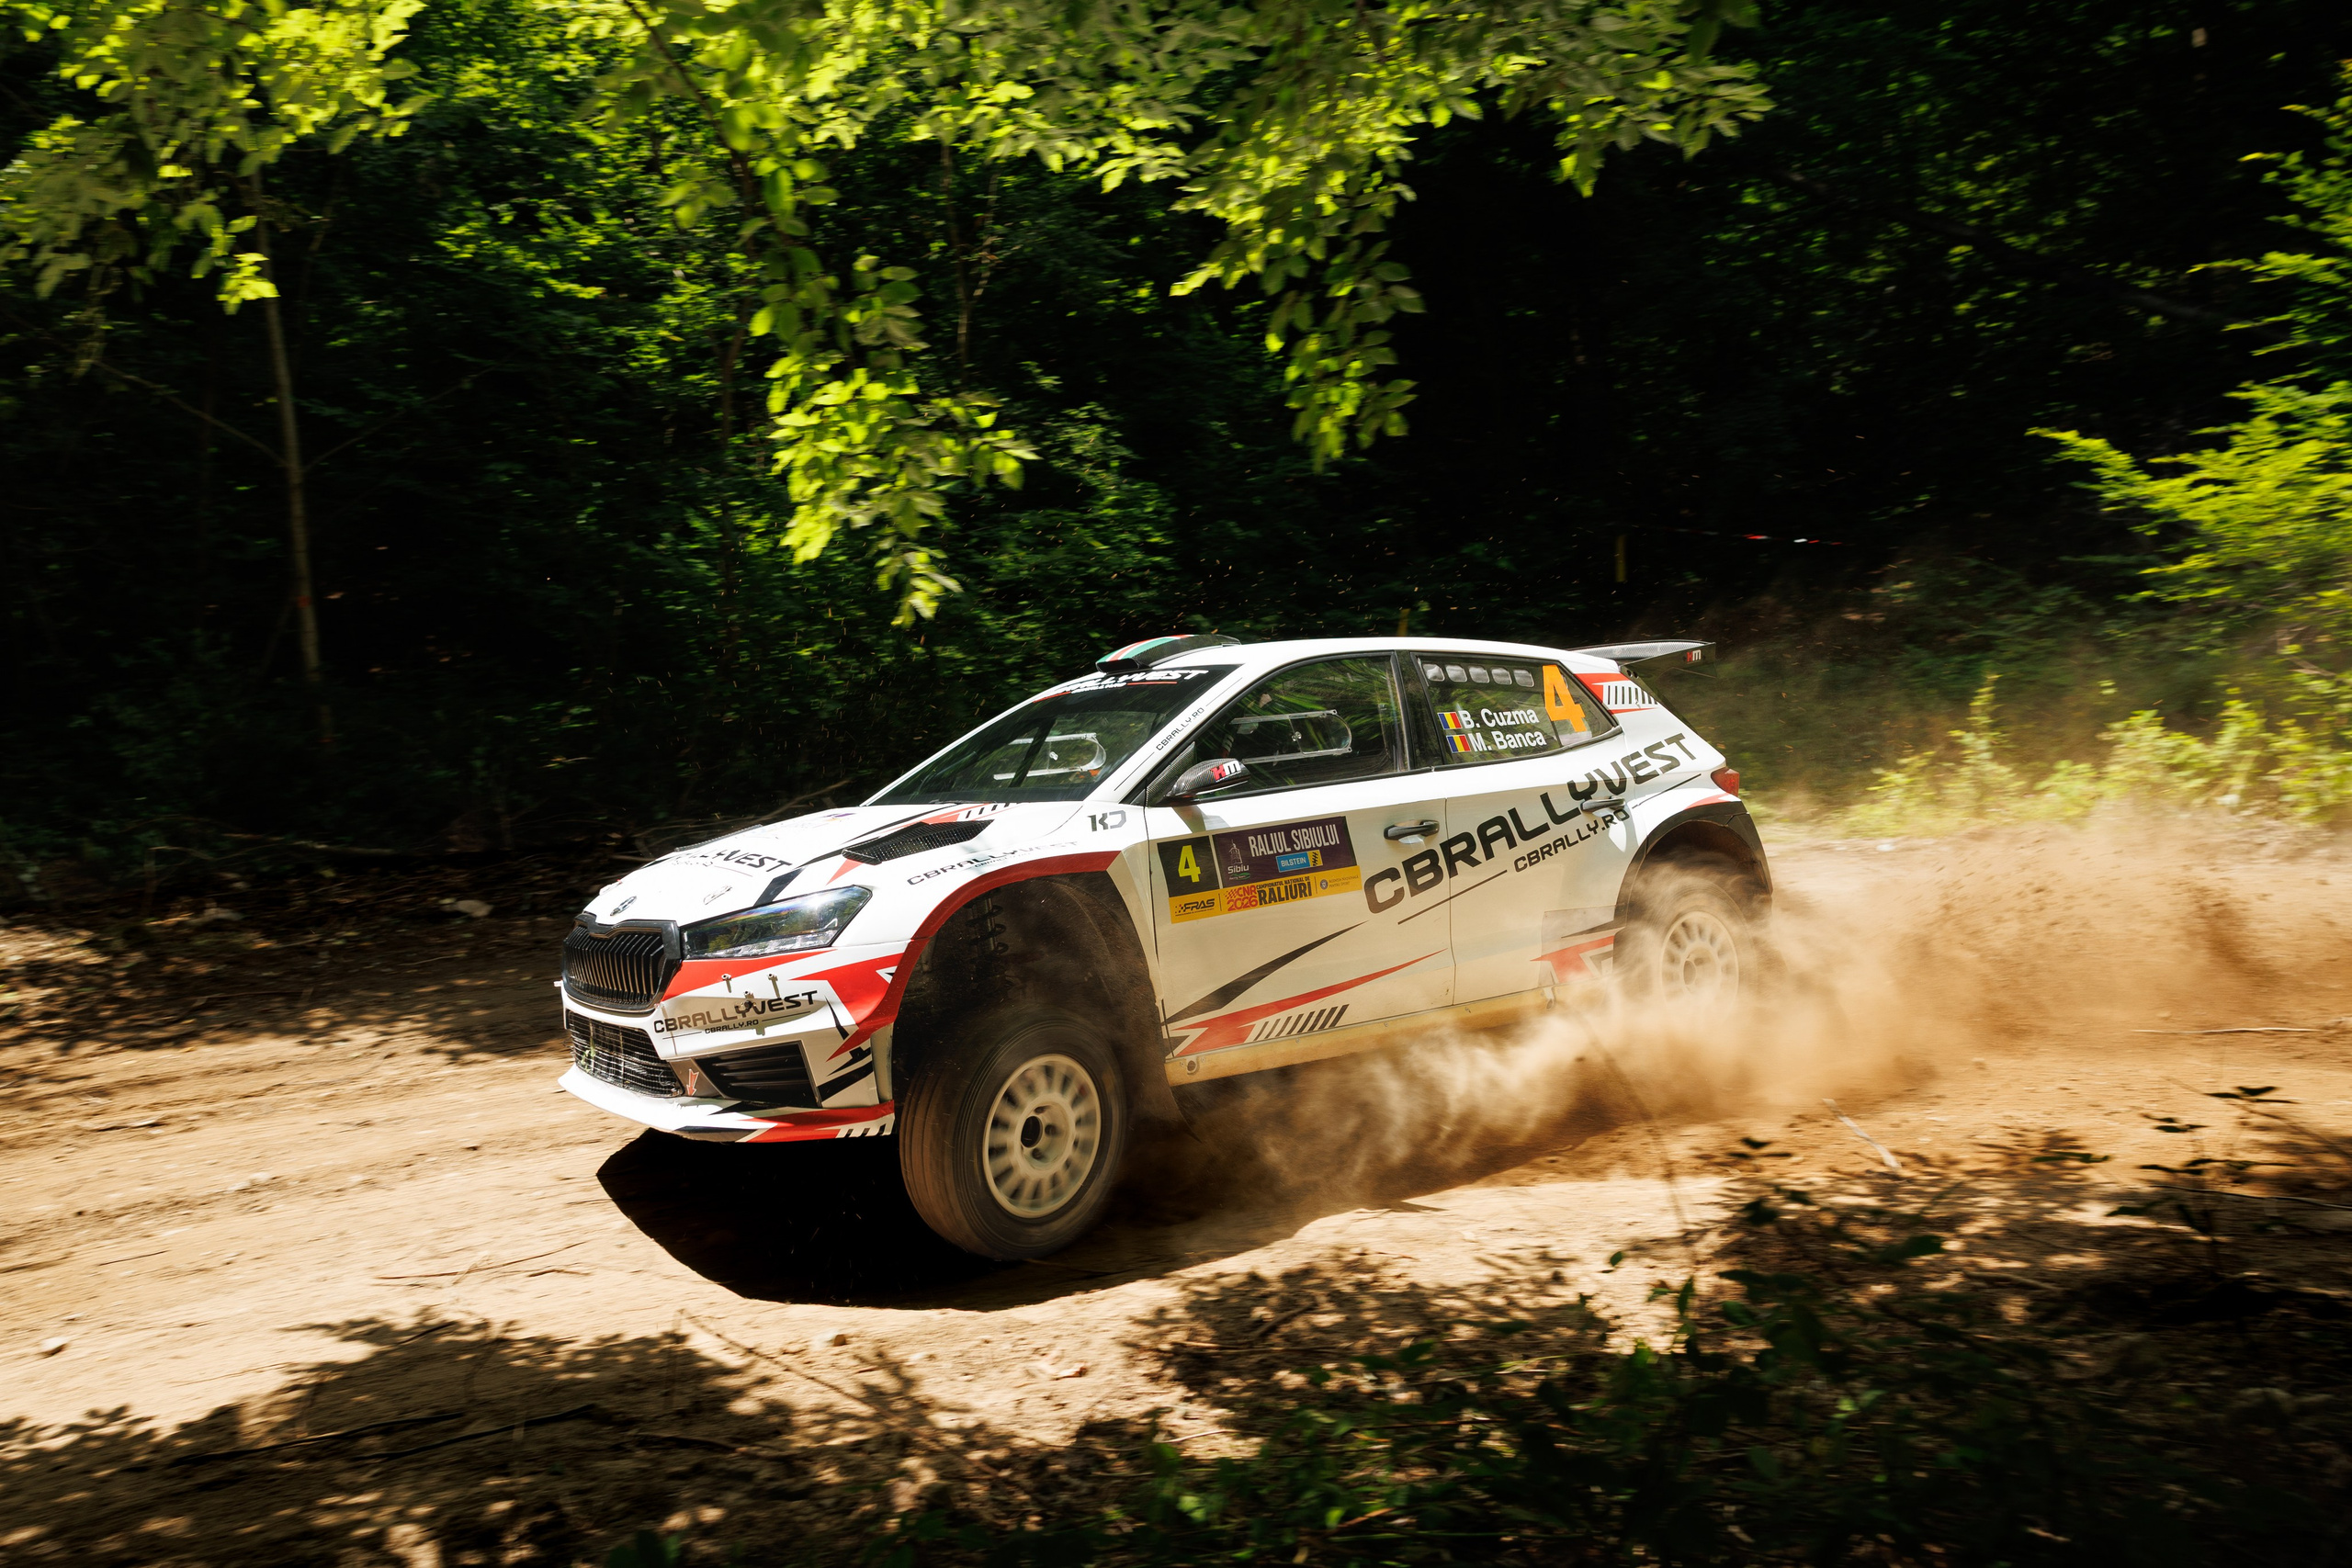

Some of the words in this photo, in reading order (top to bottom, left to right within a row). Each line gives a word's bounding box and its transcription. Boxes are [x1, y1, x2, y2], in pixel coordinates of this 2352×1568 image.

[1542, 664, 1587, 733] 4
[1156, 706, 1204, 751] CBRALLY.RO
[1459, 712, 1480, 729] B.
[1484, 707, 1540, 728] Cuzma
[1470, 734, 1492, 752] M.
[1496, 729, 1547, 750] Banca
[1363, 733, 1697, 914] CBRALLYVEST
[1248, 829, 1292, 858] RALIUL
[1291, 824, 1340, 852] SIBIULUI
[1513, 808, 1631, 873] CBRALLY.RO
[1178, 844, 1201, 883] 4
[1227, 863, 1250, 874] Sibiu
[1281, 857, 1306, 867] BILSTEIN
[1227, 895, 1258, 911] 2026
[1237, 885, 1257, 897] CNR
[1257, 881, 1312, 906] RALIURI
[1182, 898, 1215, 912] FRAS
[654, 990, 818, 1033] CBRALLYVEST
[705, 1019, 759, 1034] CBRALLY.RO
